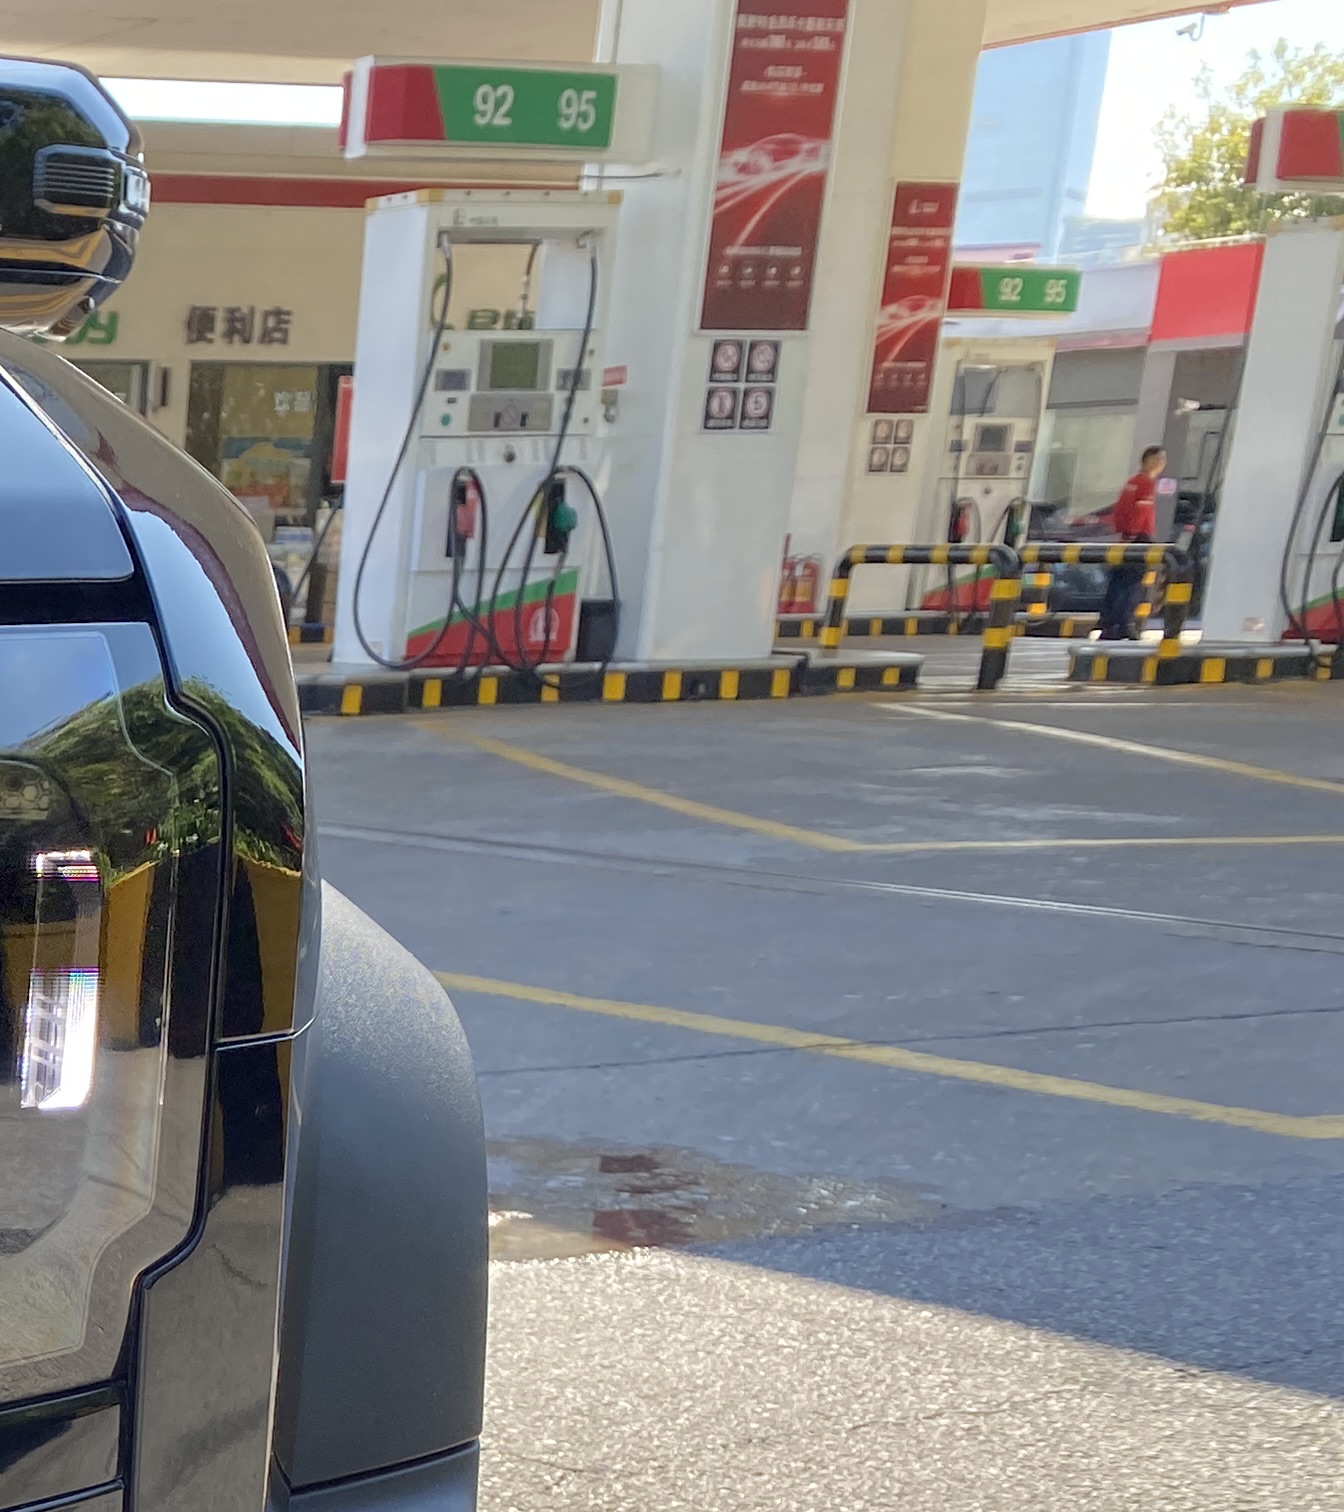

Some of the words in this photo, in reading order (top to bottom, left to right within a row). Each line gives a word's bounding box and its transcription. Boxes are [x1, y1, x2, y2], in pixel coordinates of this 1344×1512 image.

[474, 84, 514, 126] 92
[558, 88, 597, 132] 95
[999, 277, 1024, 302] 92
[1044, 279, 1067, 304] 95
[185, 305, 292, 345] 便利店
